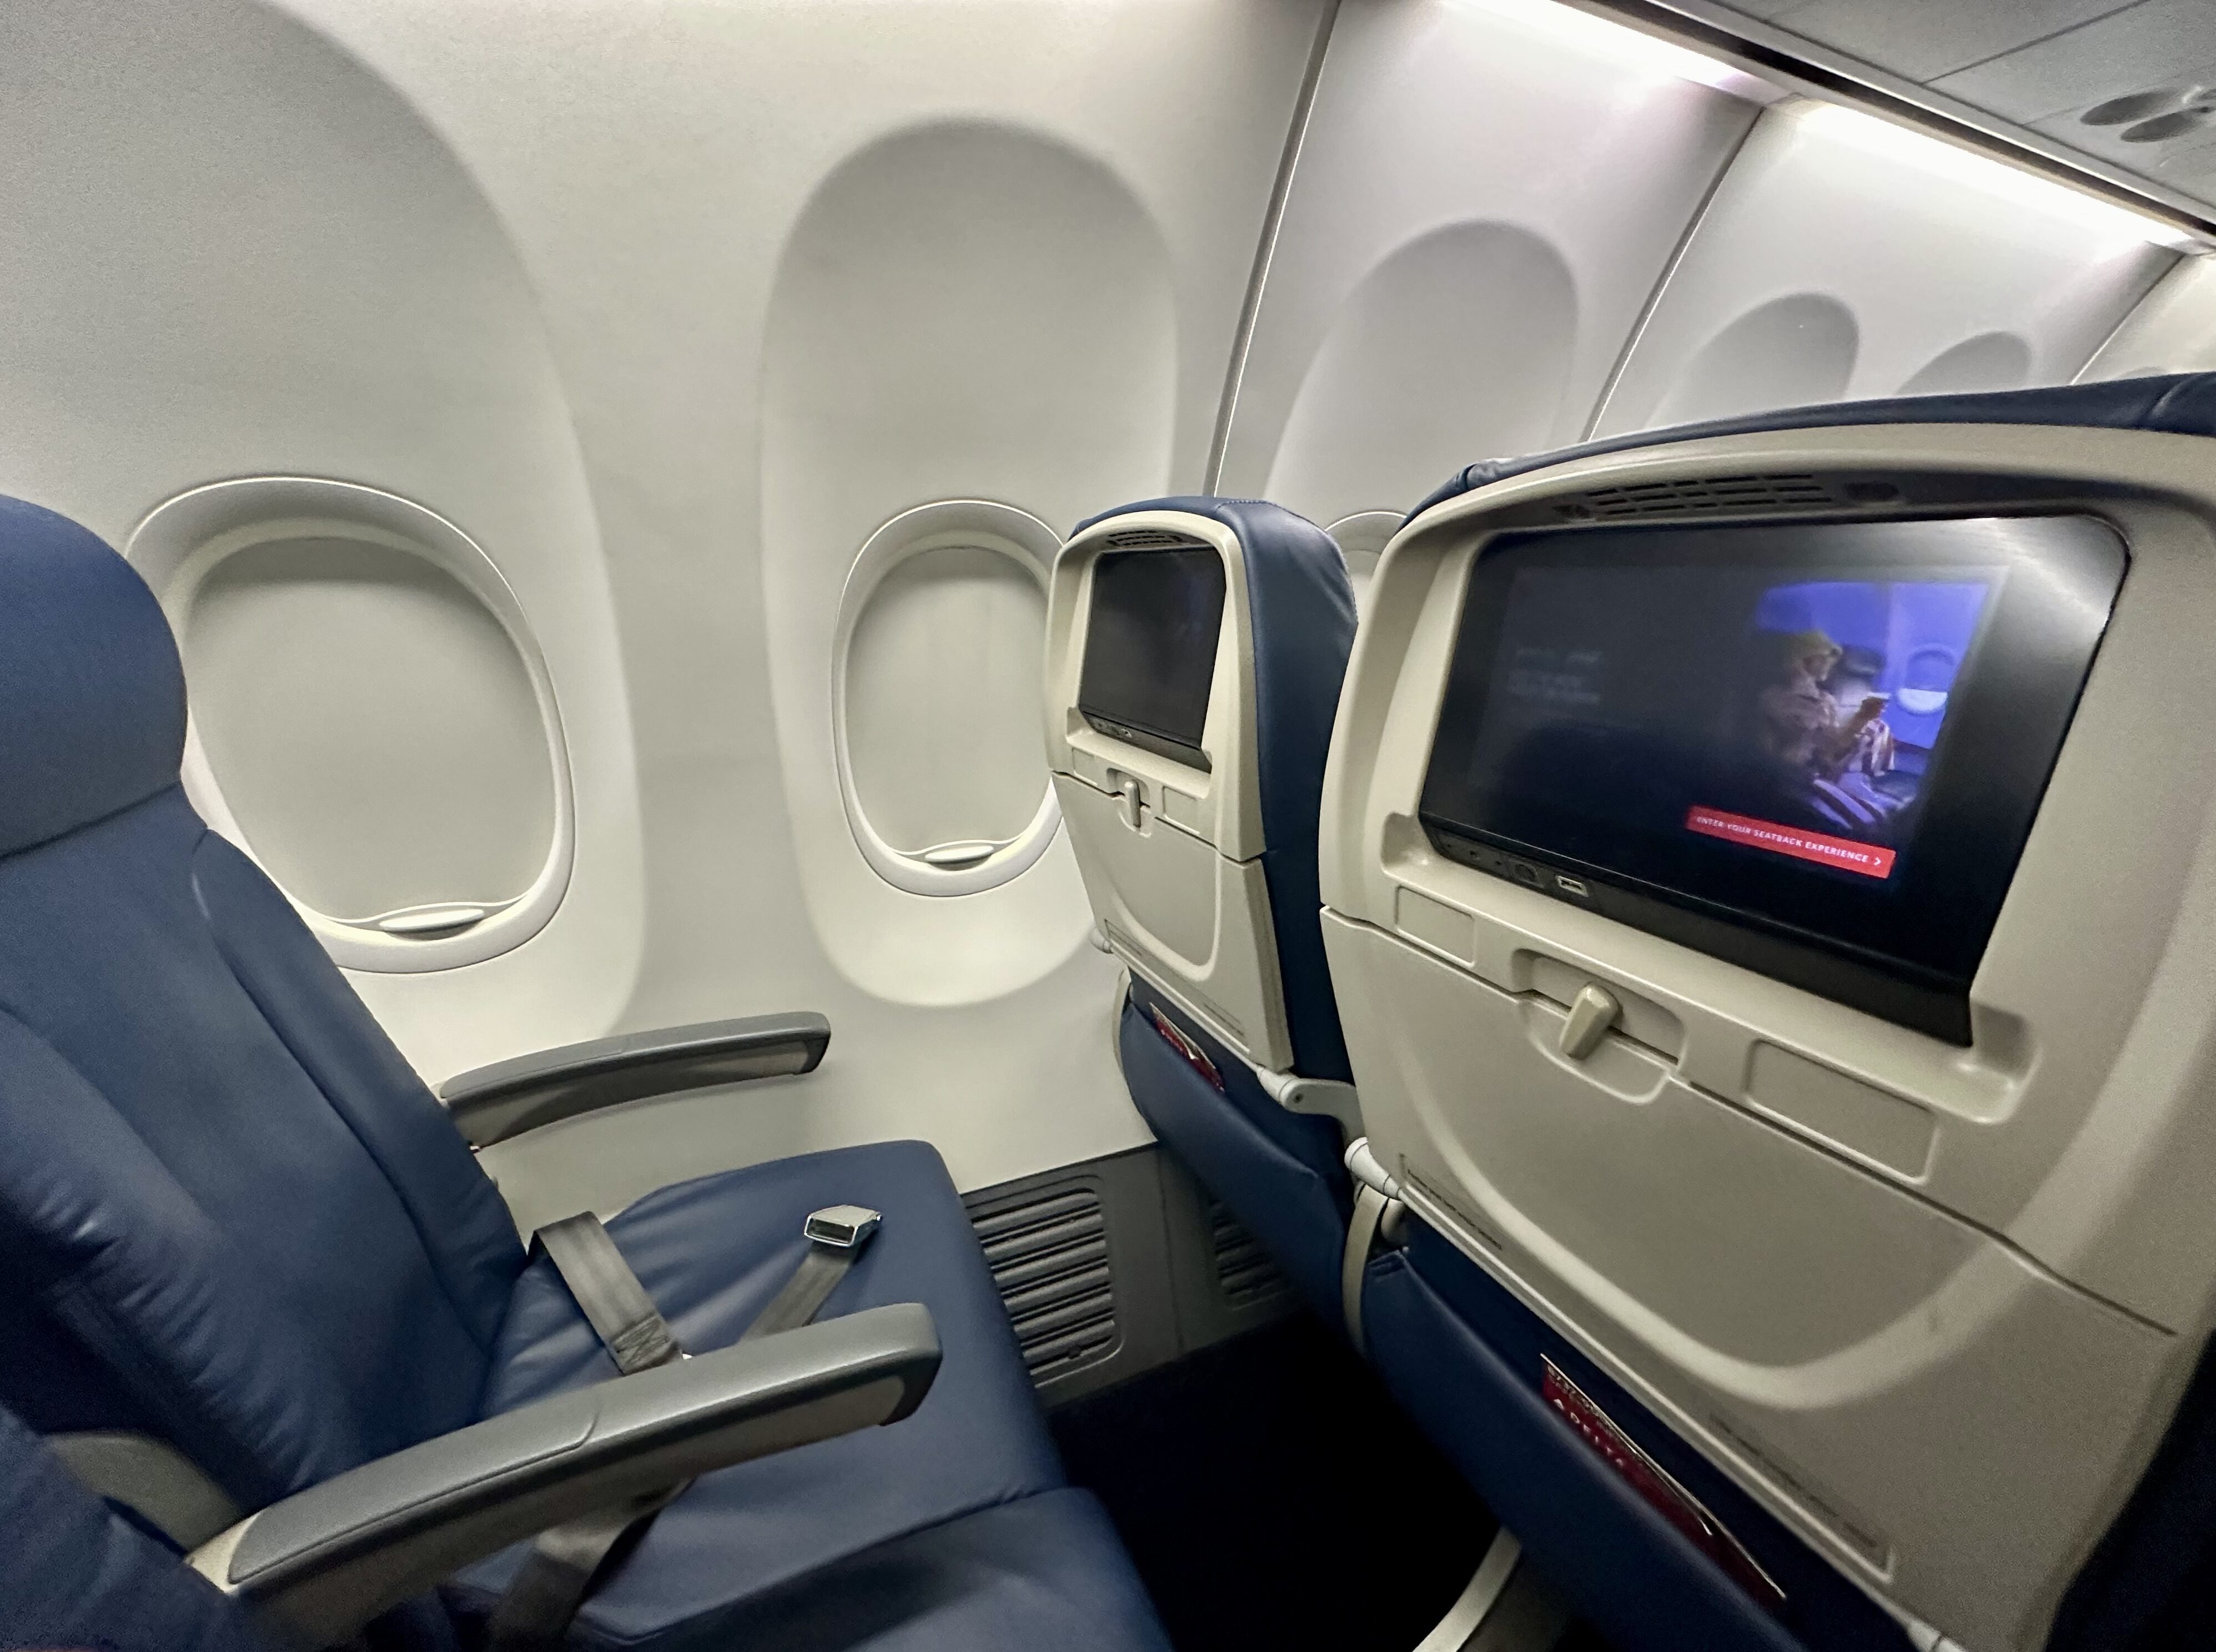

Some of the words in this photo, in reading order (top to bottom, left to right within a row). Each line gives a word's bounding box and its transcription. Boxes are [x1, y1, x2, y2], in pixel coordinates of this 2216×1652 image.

[1696, 816, 1724, 828] ENTER
[1727, 823, 1751, 834] YOUR
[1753, 829, 1802, 847] SEATBACK
[1805, 842, 1869, 863] EXPERIENCE
